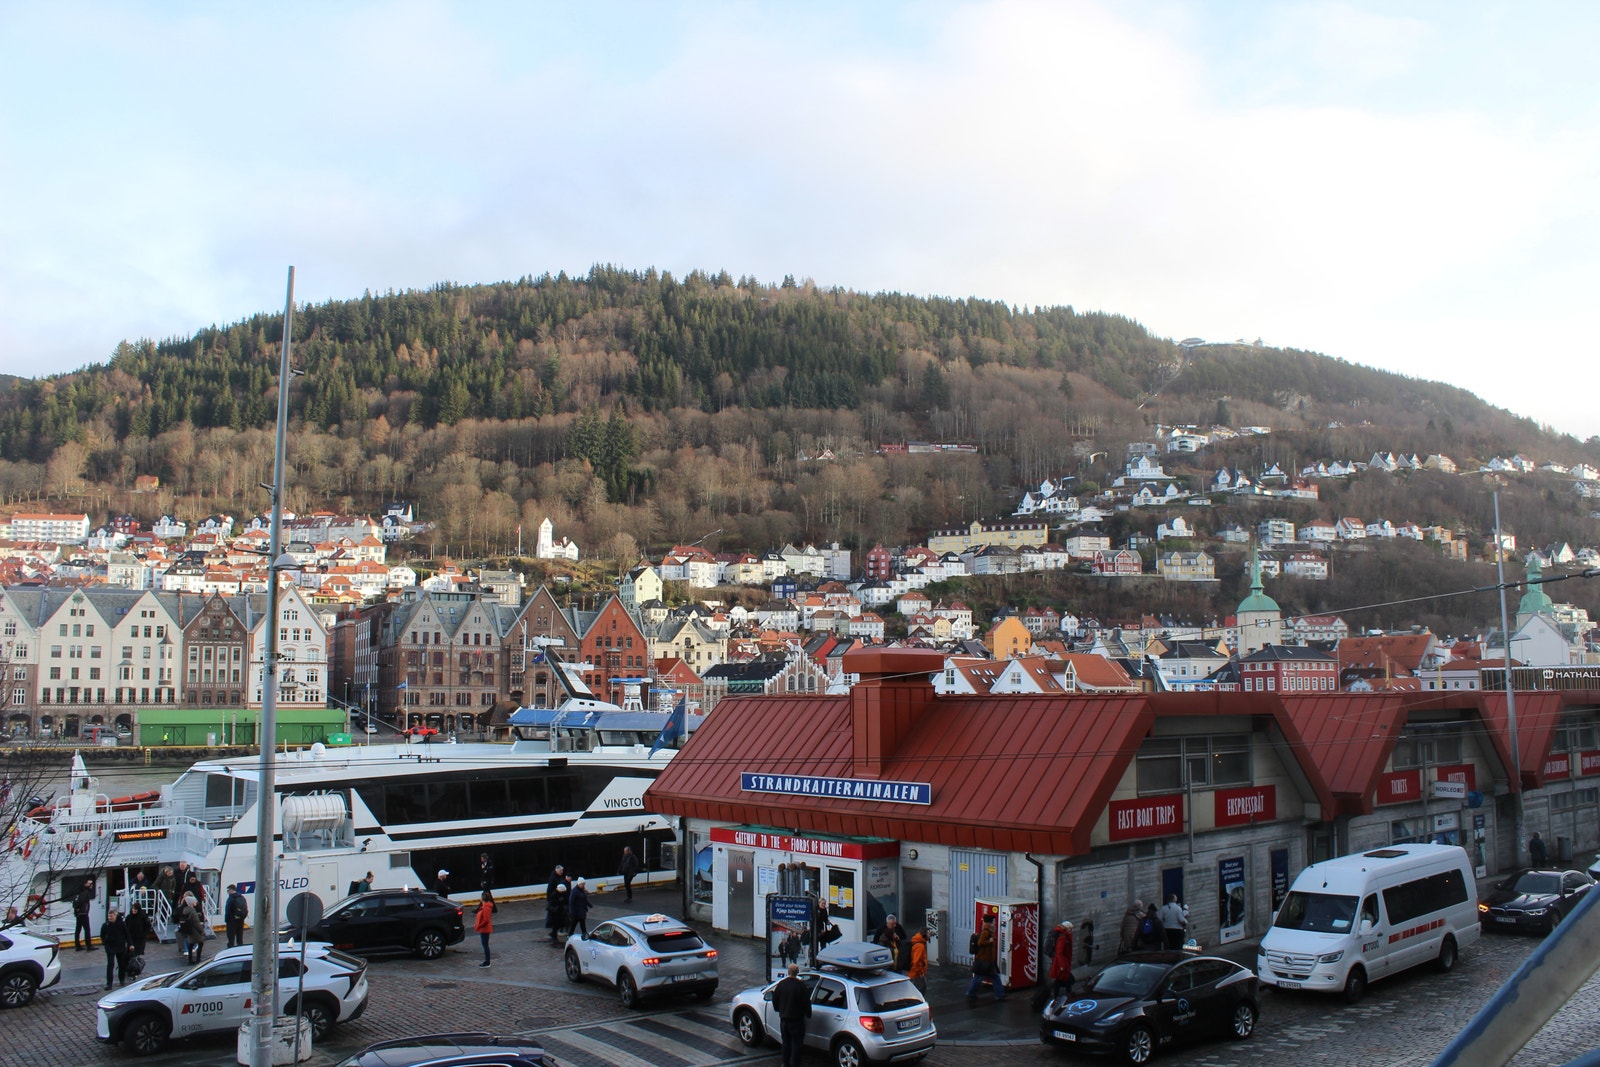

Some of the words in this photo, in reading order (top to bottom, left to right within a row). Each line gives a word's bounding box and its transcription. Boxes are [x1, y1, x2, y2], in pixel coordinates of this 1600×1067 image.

[750, 775, 920, 801] STRANDKAITERMINALEN
[1391, 778, 1408, 795] TICKETS
[603, 797, 645, 808] VINGTO
[1227, 793, 1264, 817] EKSPRESSBÅT
[1118, 809, 1134, 830] FAST
[1136, 807, 1154, 828] BOAT
[1156, 805, 1176, 825] TRIPS
[735, 831, 757, 845] GATEWAY
[761, 834, 767, 847] TO
[770, 835, 780, 849] THE
[790, 838, 810, 853] FJORDS
[811, 840, 818, 853] OF
[819, 841, 843, 857] NORWAY
[280, 877, 309, 890] RLED
[188, 1001, 223, 1014] 07000
